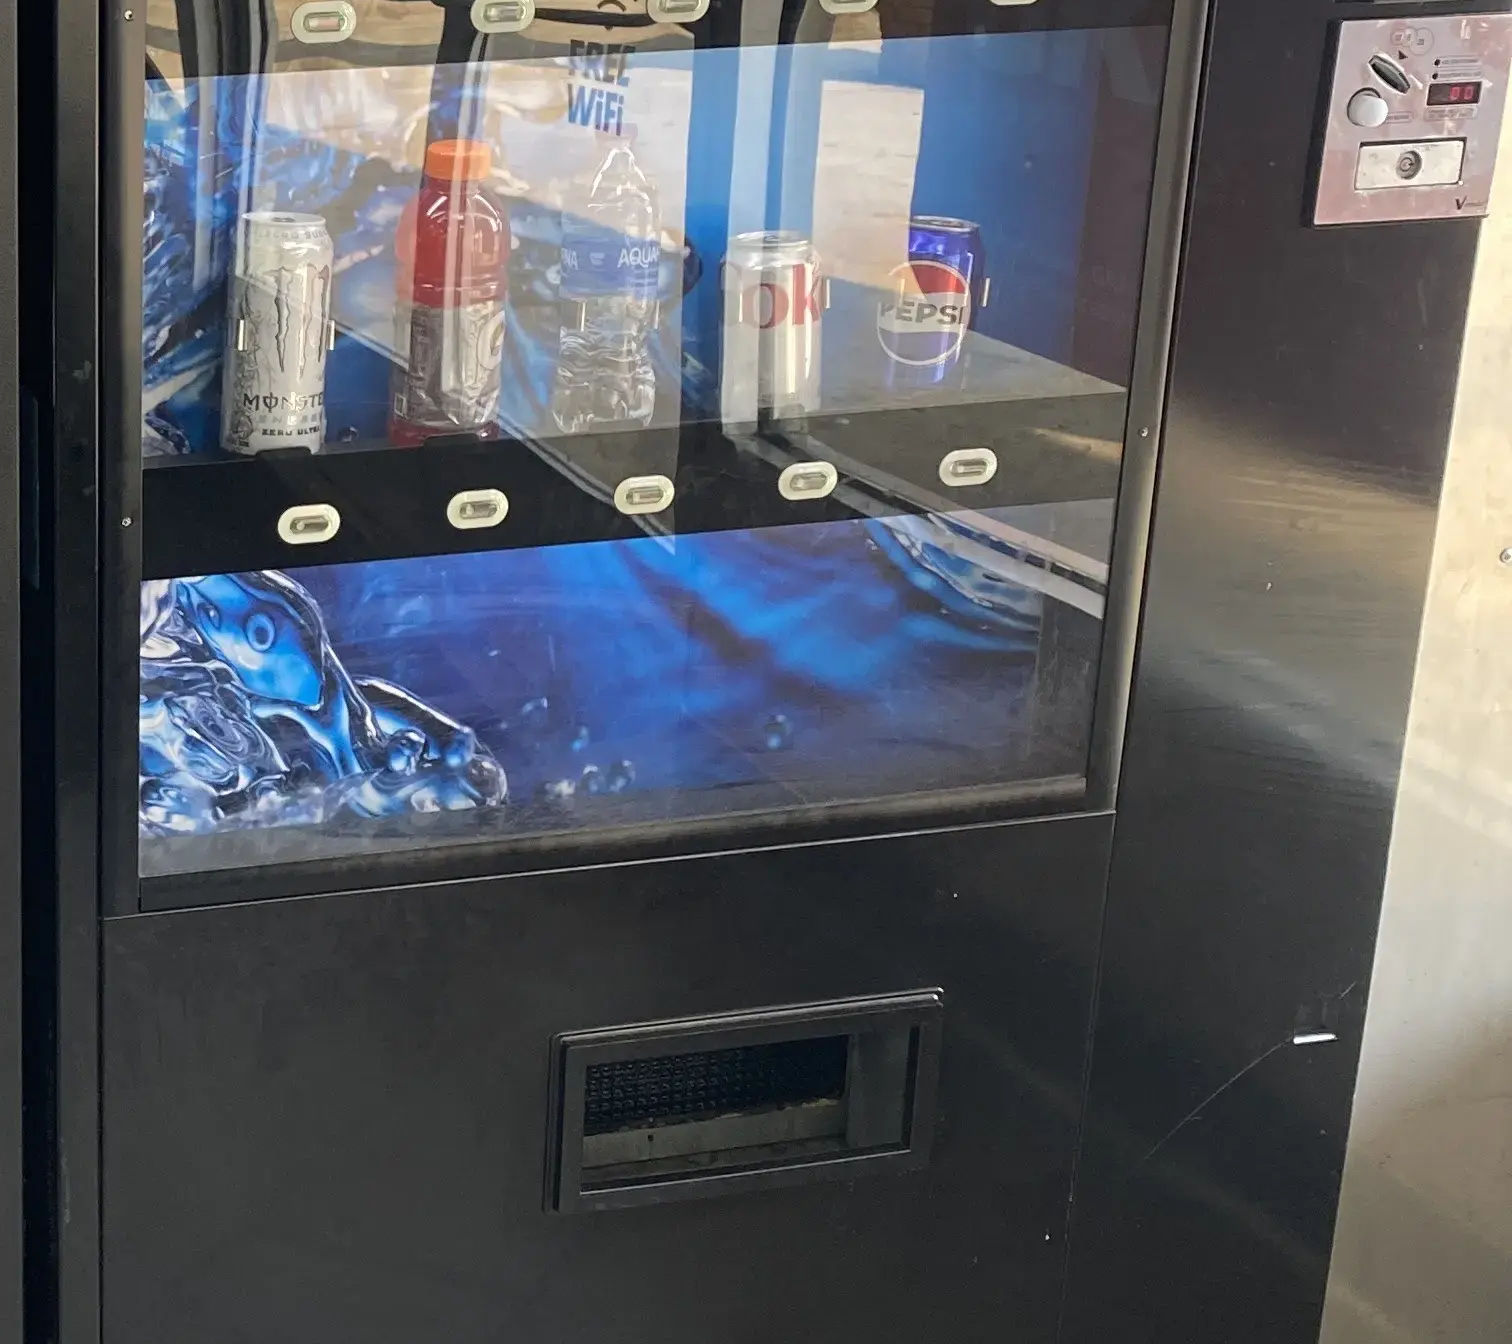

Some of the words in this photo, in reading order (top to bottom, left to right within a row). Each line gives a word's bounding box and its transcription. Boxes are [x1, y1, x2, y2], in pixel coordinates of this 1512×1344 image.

[569, 39, 636, 86] FREE
[567, 82, 626, 136] WiFi
[880, 300, 968, 327] PEPSI
